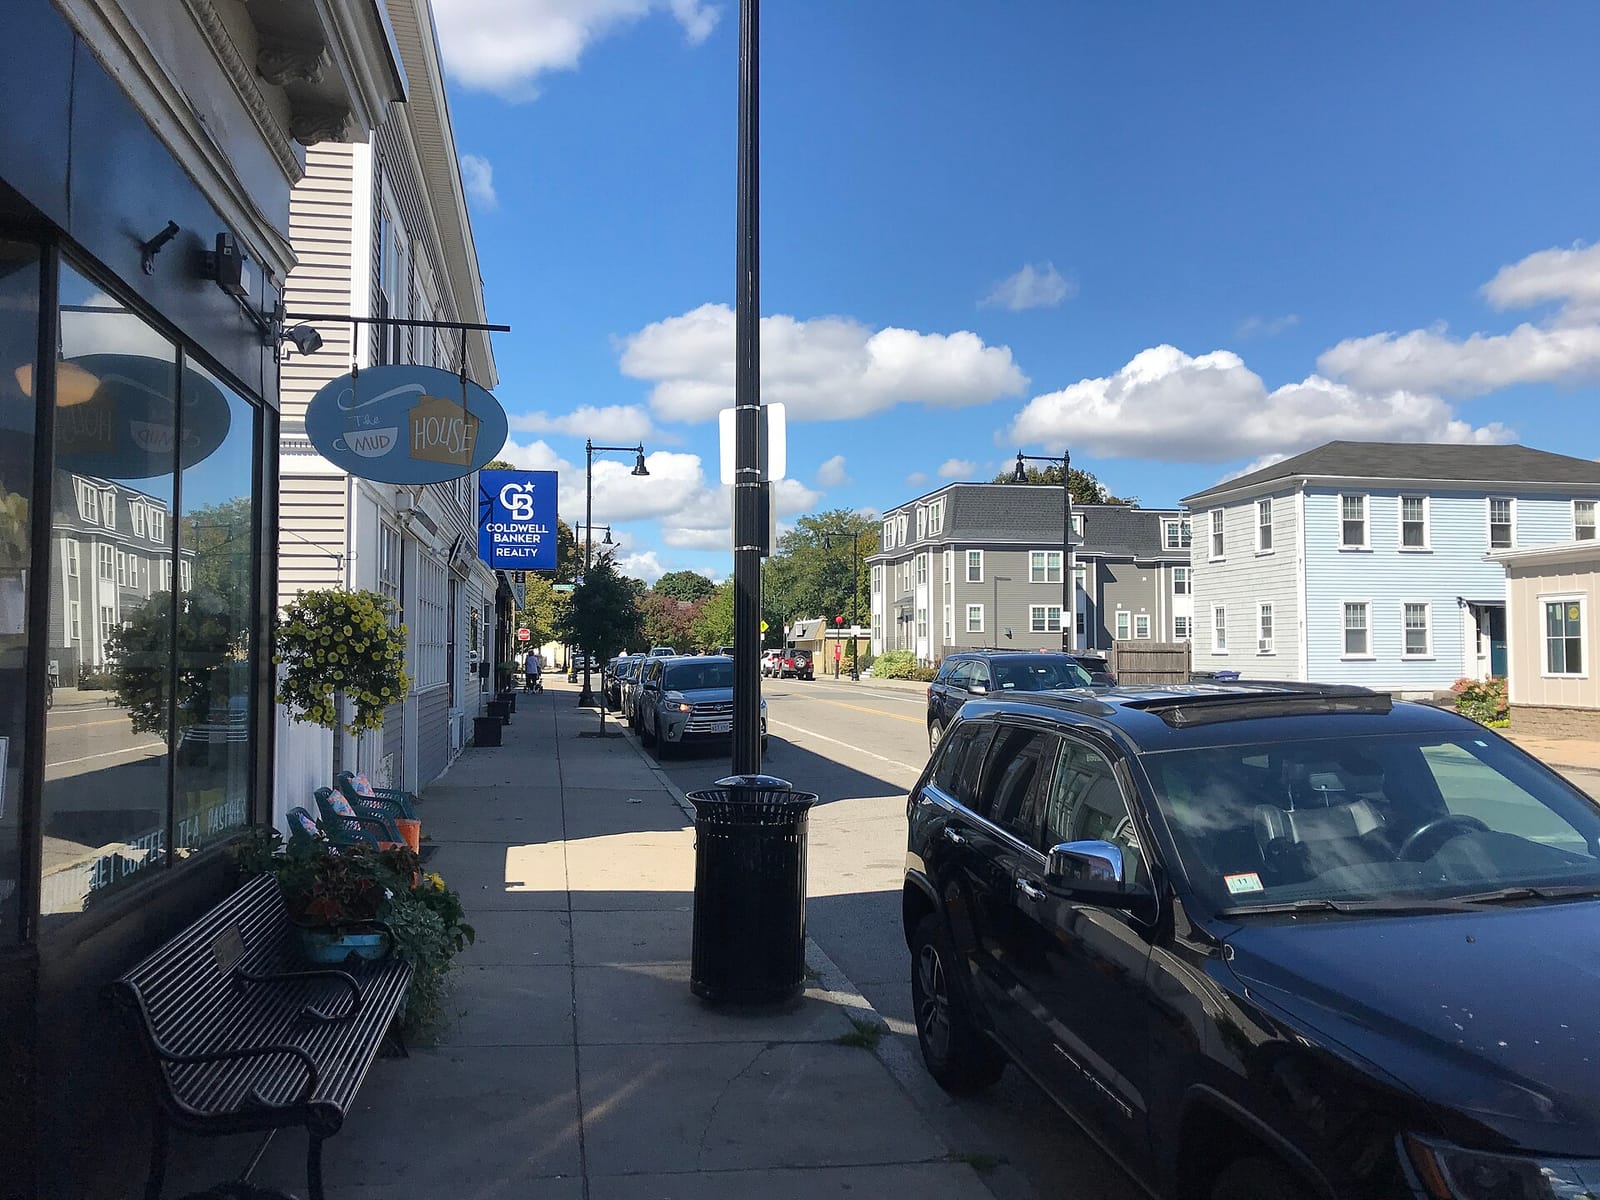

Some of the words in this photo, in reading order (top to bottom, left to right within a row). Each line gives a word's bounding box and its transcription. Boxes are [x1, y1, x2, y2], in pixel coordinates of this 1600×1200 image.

[347, 414, 382, 427] The
[355, 435, 390, 451] MUD
[415, 416, 473, 454] HOUSE
[500, 483, 534, 520] CB
[486, 523, 549, 533] COLDWELL
[493, 533, 540, 543] BANKER
[496, 548, 538, 557] REALTY
